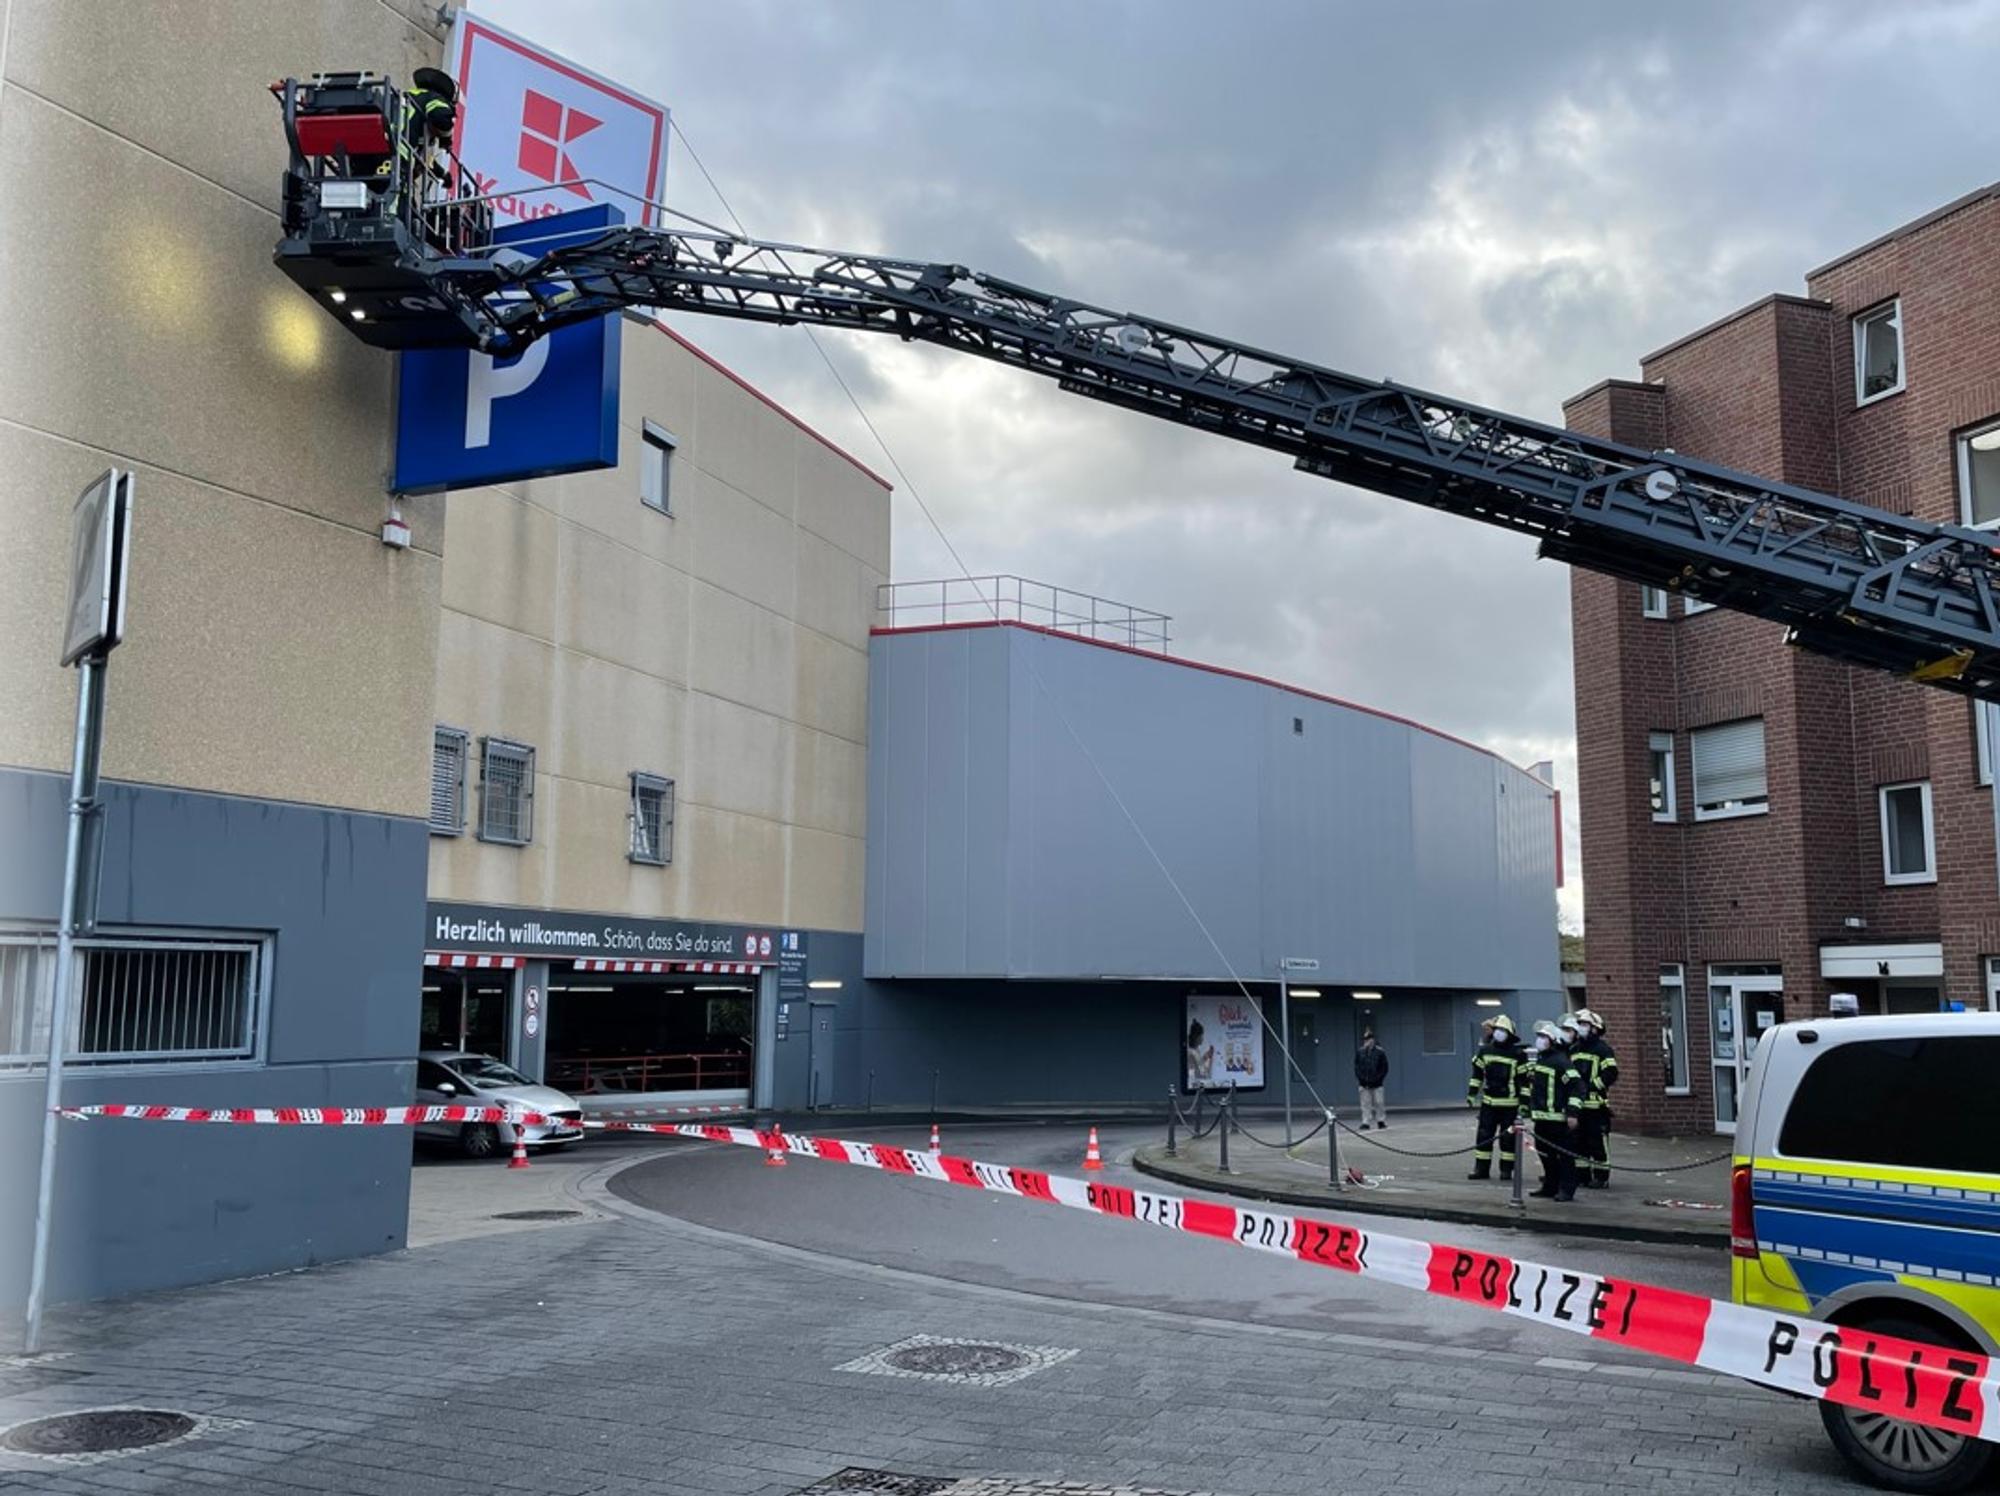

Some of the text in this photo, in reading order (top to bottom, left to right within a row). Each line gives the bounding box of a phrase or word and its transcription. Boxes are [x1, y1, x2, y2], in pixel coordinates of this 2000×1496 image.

[464, 315, 551, 449] P
[436, 915, 733, 953] Herzlich willkommen. Schön, dass Sie da sind.
[1087, 1186, 1181, 1229] POLIZEI
[1240, 1213, 1369, 1269] POLIZEI
[1452, 1253, 1637, 1335] POLIZEI
[1763, 1320, 1980, 1423] POLIZ
